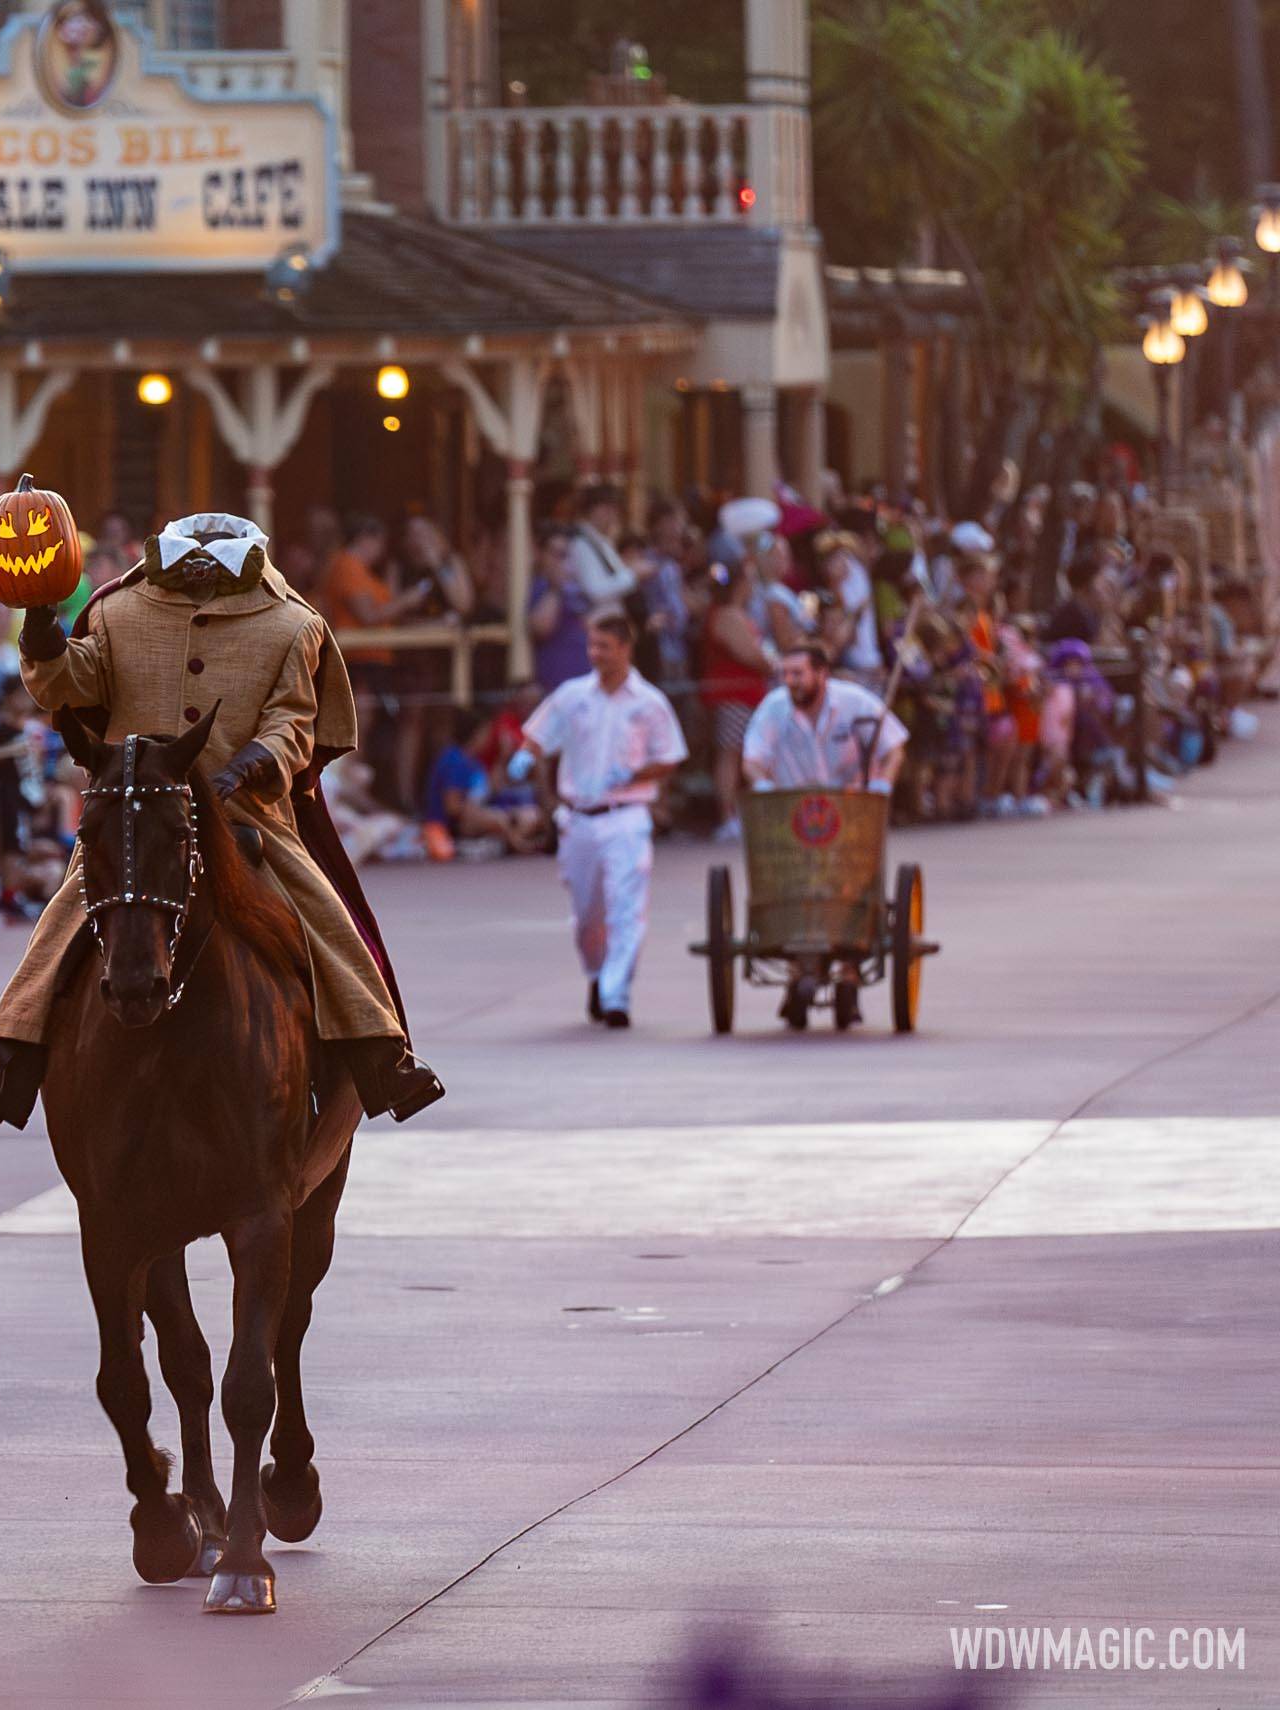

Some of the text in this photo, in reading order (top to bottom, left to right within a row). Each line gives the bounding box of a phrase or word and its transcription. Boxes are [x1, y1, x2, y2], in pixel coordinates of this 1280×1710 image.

[116, 124, 242, 166] BILL
[86, 175, 157, 231] INN
[203, 159, 302, 231] CAFE
